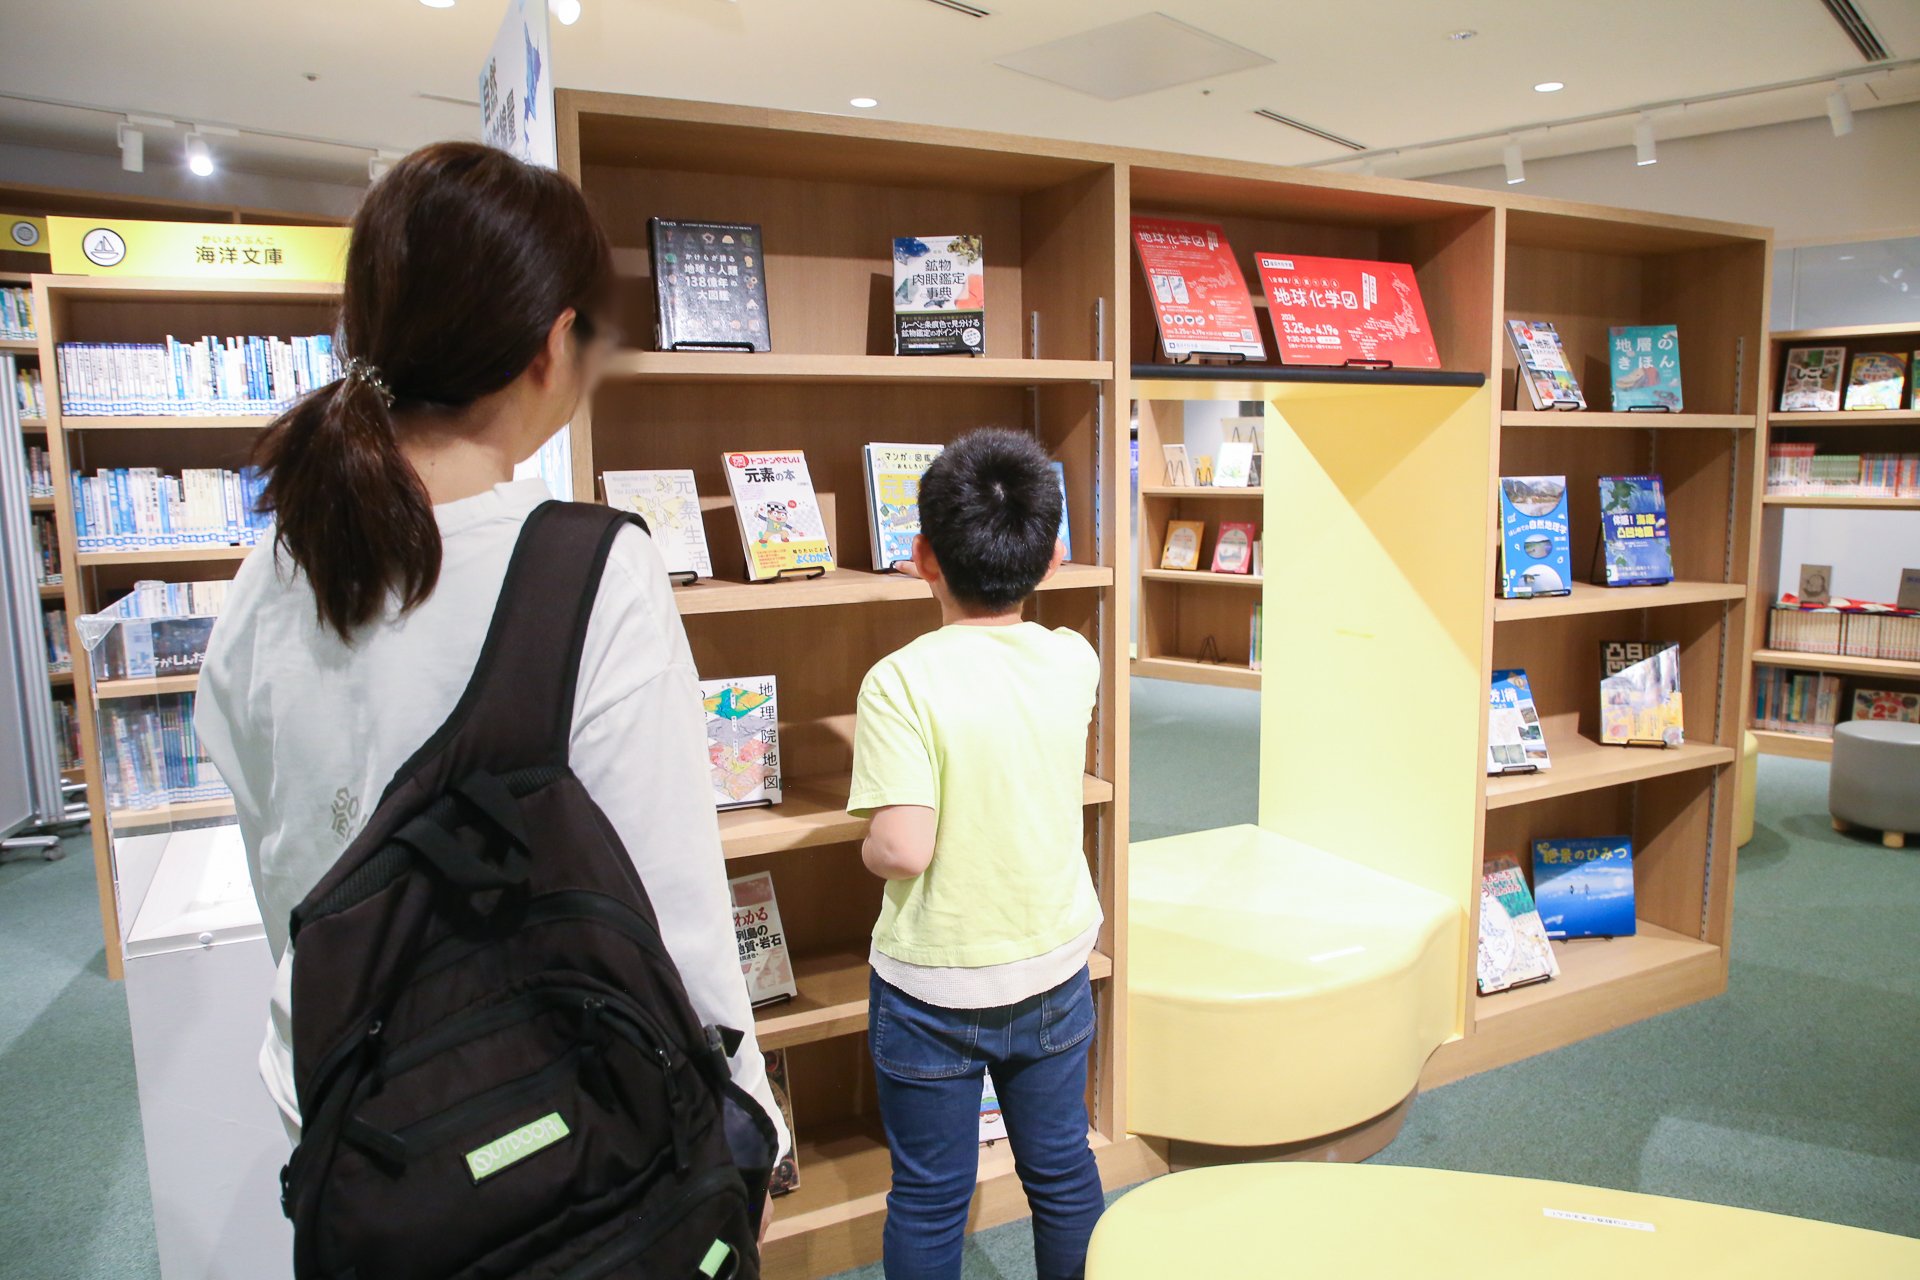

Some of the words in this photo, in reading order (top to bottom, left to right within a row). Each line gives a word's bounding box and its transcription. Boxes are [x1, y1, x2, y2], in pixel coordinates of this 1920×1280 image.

[196, 246, 283, 265] 海洋文庫
[684, 264, 739, 277] 地球と人類
[925, 259, 952, 272] 鉱物
[685, 276, 738, 288] 138億年の
[912, 272, 965, 286] 肉眼鑑定
[926, 286, 952, 299] 事典
[1273, 286, 1358, 309] 地球化学図
[1615, 336, 1674, 353] 地層の
[1617, 355, 1675, 371] きほん
[750, 457, 801, 465] トコトンやさしい
[745, 467, 796, 483] 元素の本
[673, 475, 710, 572] 元素生活
[796, 552, 831, 564] よくわかる
[758, 682, 778, 790] 地理院地図
[735, 906, 768, 927] わかる
